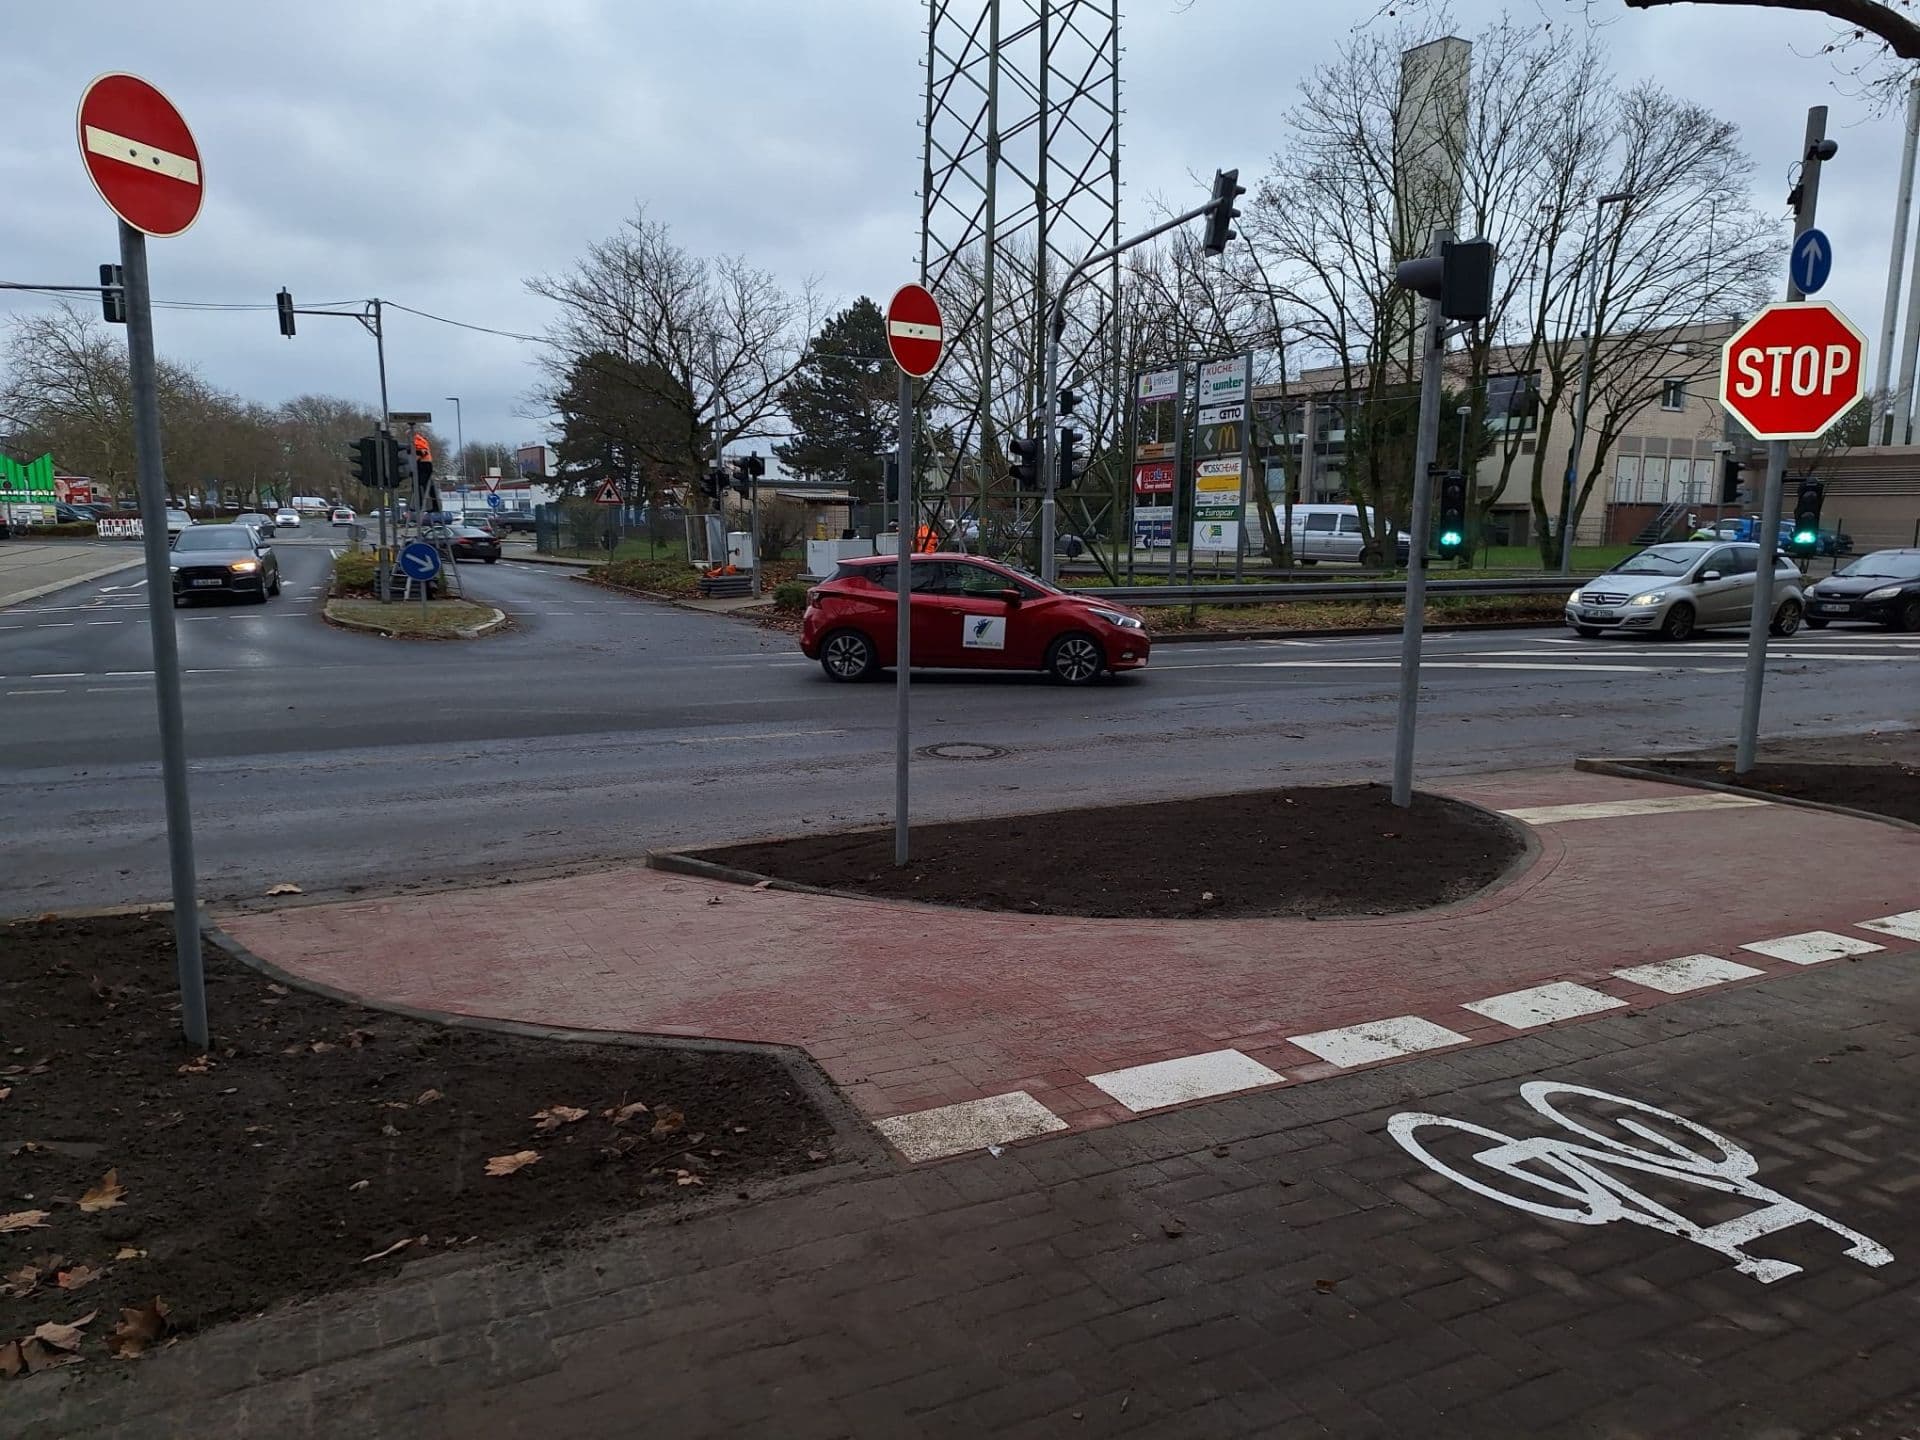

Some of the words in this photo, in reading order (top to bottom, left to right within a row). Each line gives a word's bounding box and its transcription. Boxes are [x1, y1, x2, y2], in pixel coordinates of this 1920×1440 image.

[1735, 344, 1851, 398] STOP
[1212, 376, 1244, 391] winter
[1204, 507, 1235, 518] Europcar
